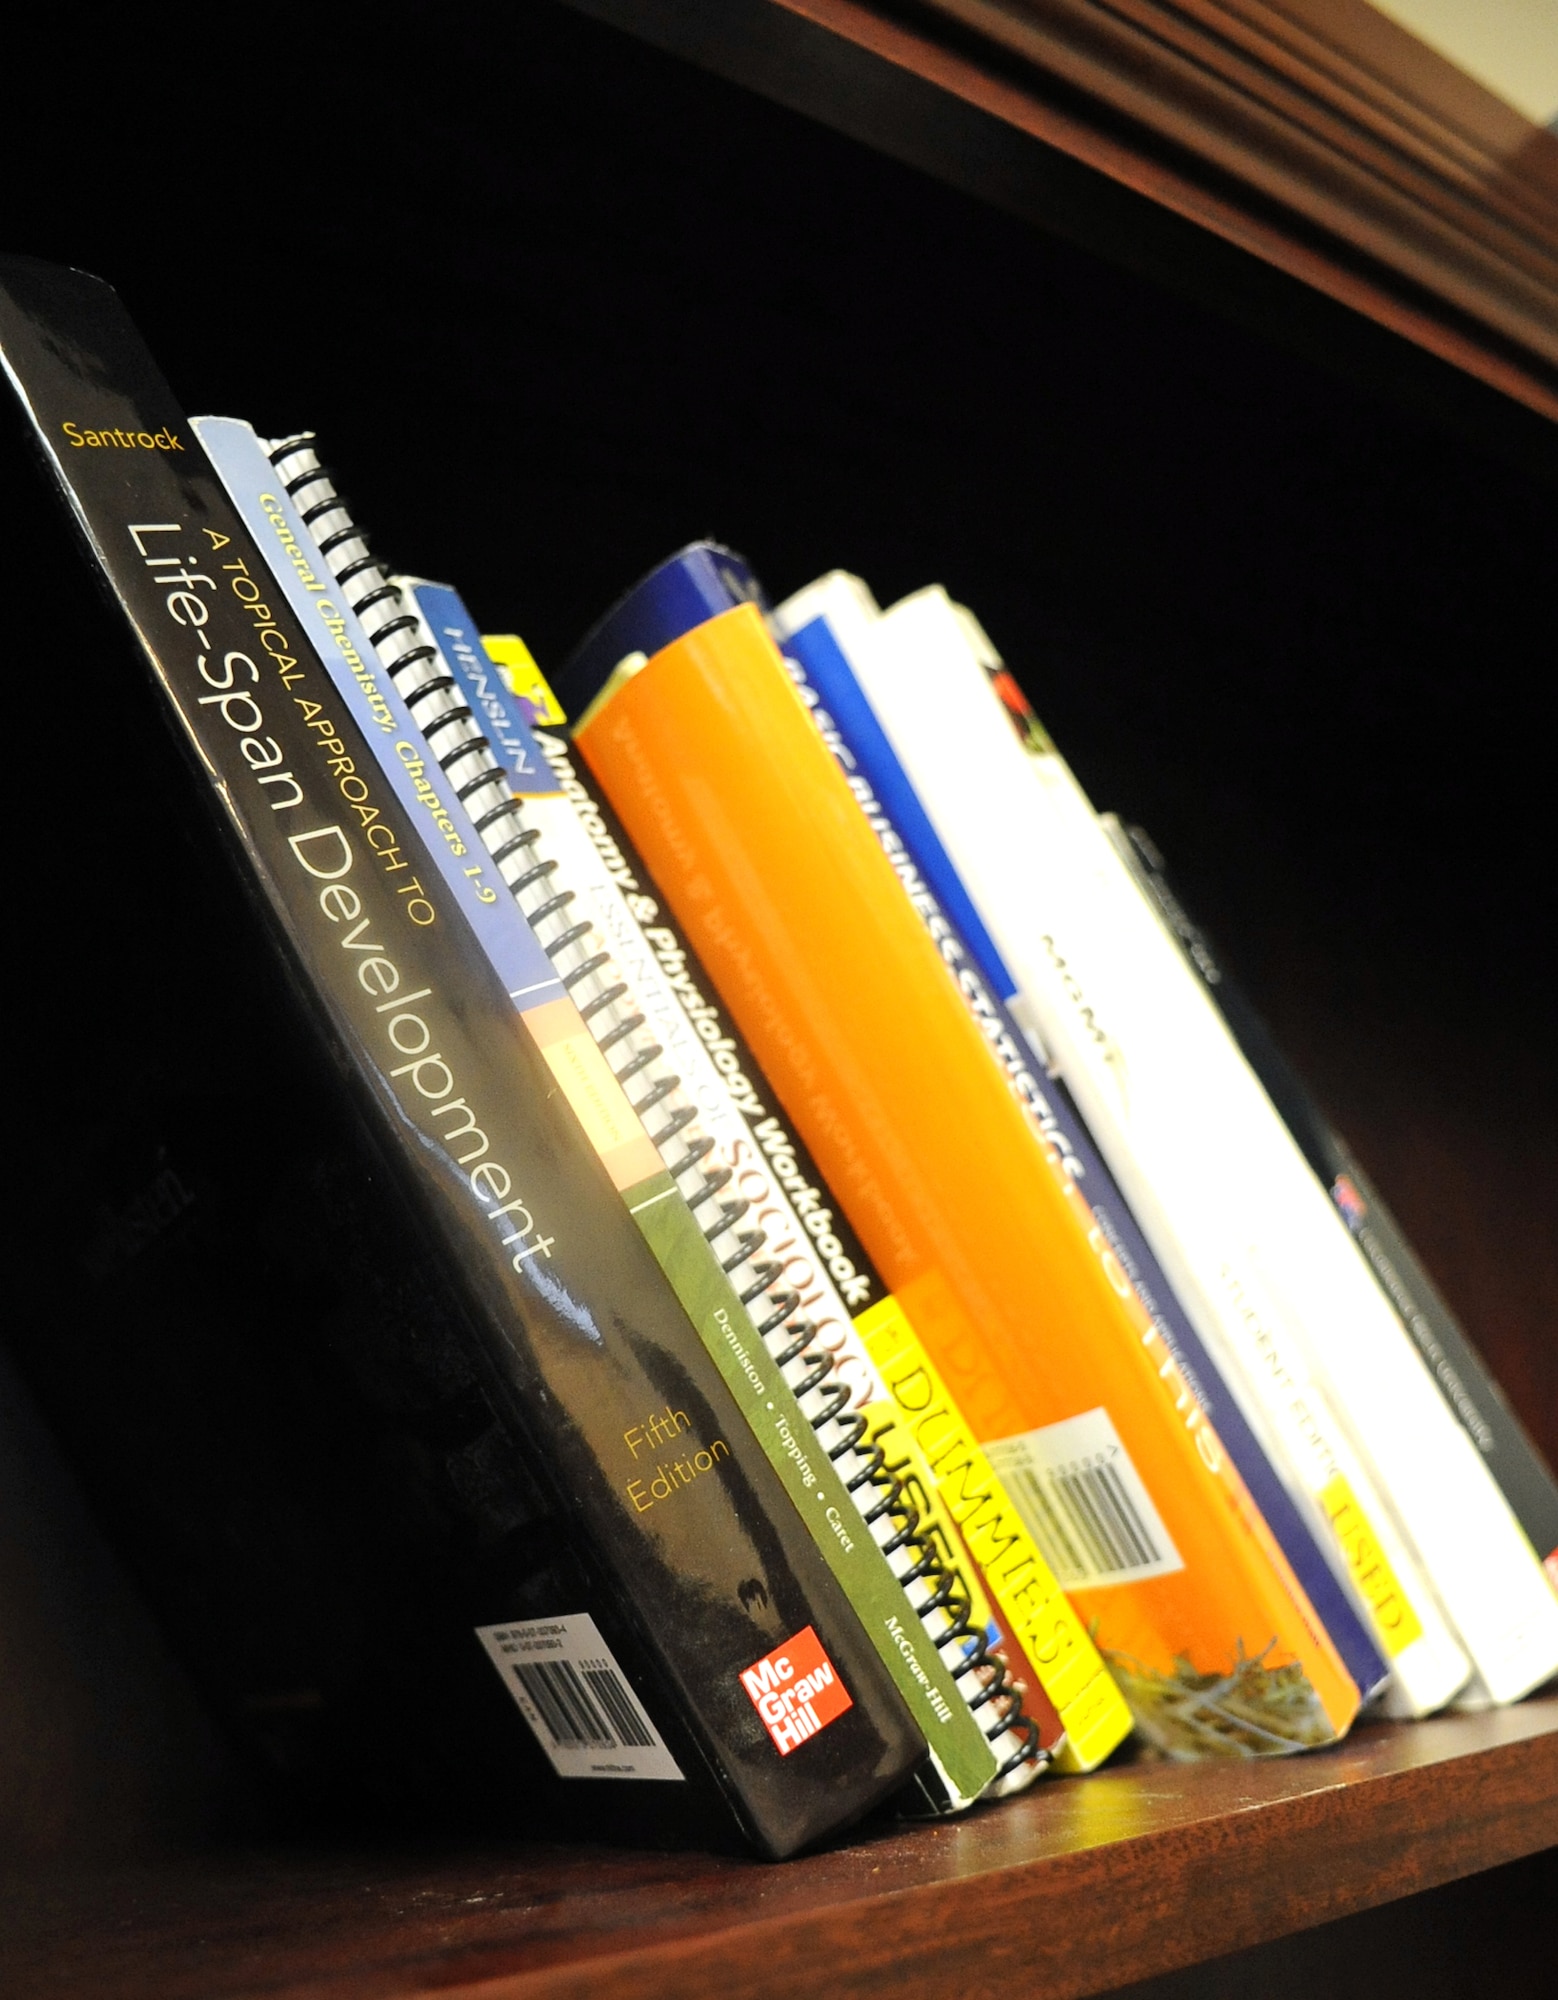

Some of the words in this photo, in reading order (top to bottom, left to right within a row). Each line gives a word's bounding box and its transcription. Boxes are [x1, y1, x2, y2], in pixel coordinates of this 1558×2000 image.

[62, 422, 185, 452] Santrock
[203, 529, 230, 550] A
[222, 558, 307, 691] TOPICAL
[295, 698, 407, 872] APPROACH
[397, 877, 435, 926] TO
[258, 492, 325, 592] General
[316, 599, 396, 734] Chemistry,
[395, 740, 467, 858] Chapters
[462, 865, 497, 904] 1-9
[443, 626, 535, 775] HENSLIN
[127, 523, 304, 811] Life-Span
[288, 825, 555, 1273] Development
[626, 890, 660, 924] &
[646, 928, 765, 1127] Physiology
[754, 1120, 873, 1306] Workbook
[958, 967, 1086, 1178] STATISTICS
[623, 1405, 692, 1462] Fifth
[625, 1436, 730, 1514] Edition
[713, 1308, 766, 1396] Denniston
[773, 1412, 818, 1488] Topping
[824, 1506, 856, 1553] Caret
[1330, 1503, 1402, 1635] USED
[742, 1655, 794, 1696] Mc
[758, 1661, 835, 1724] Graw
[770, 1703, 821, 1755] Hill
[884, 1615, 954, 1724] McGraw-Hill
